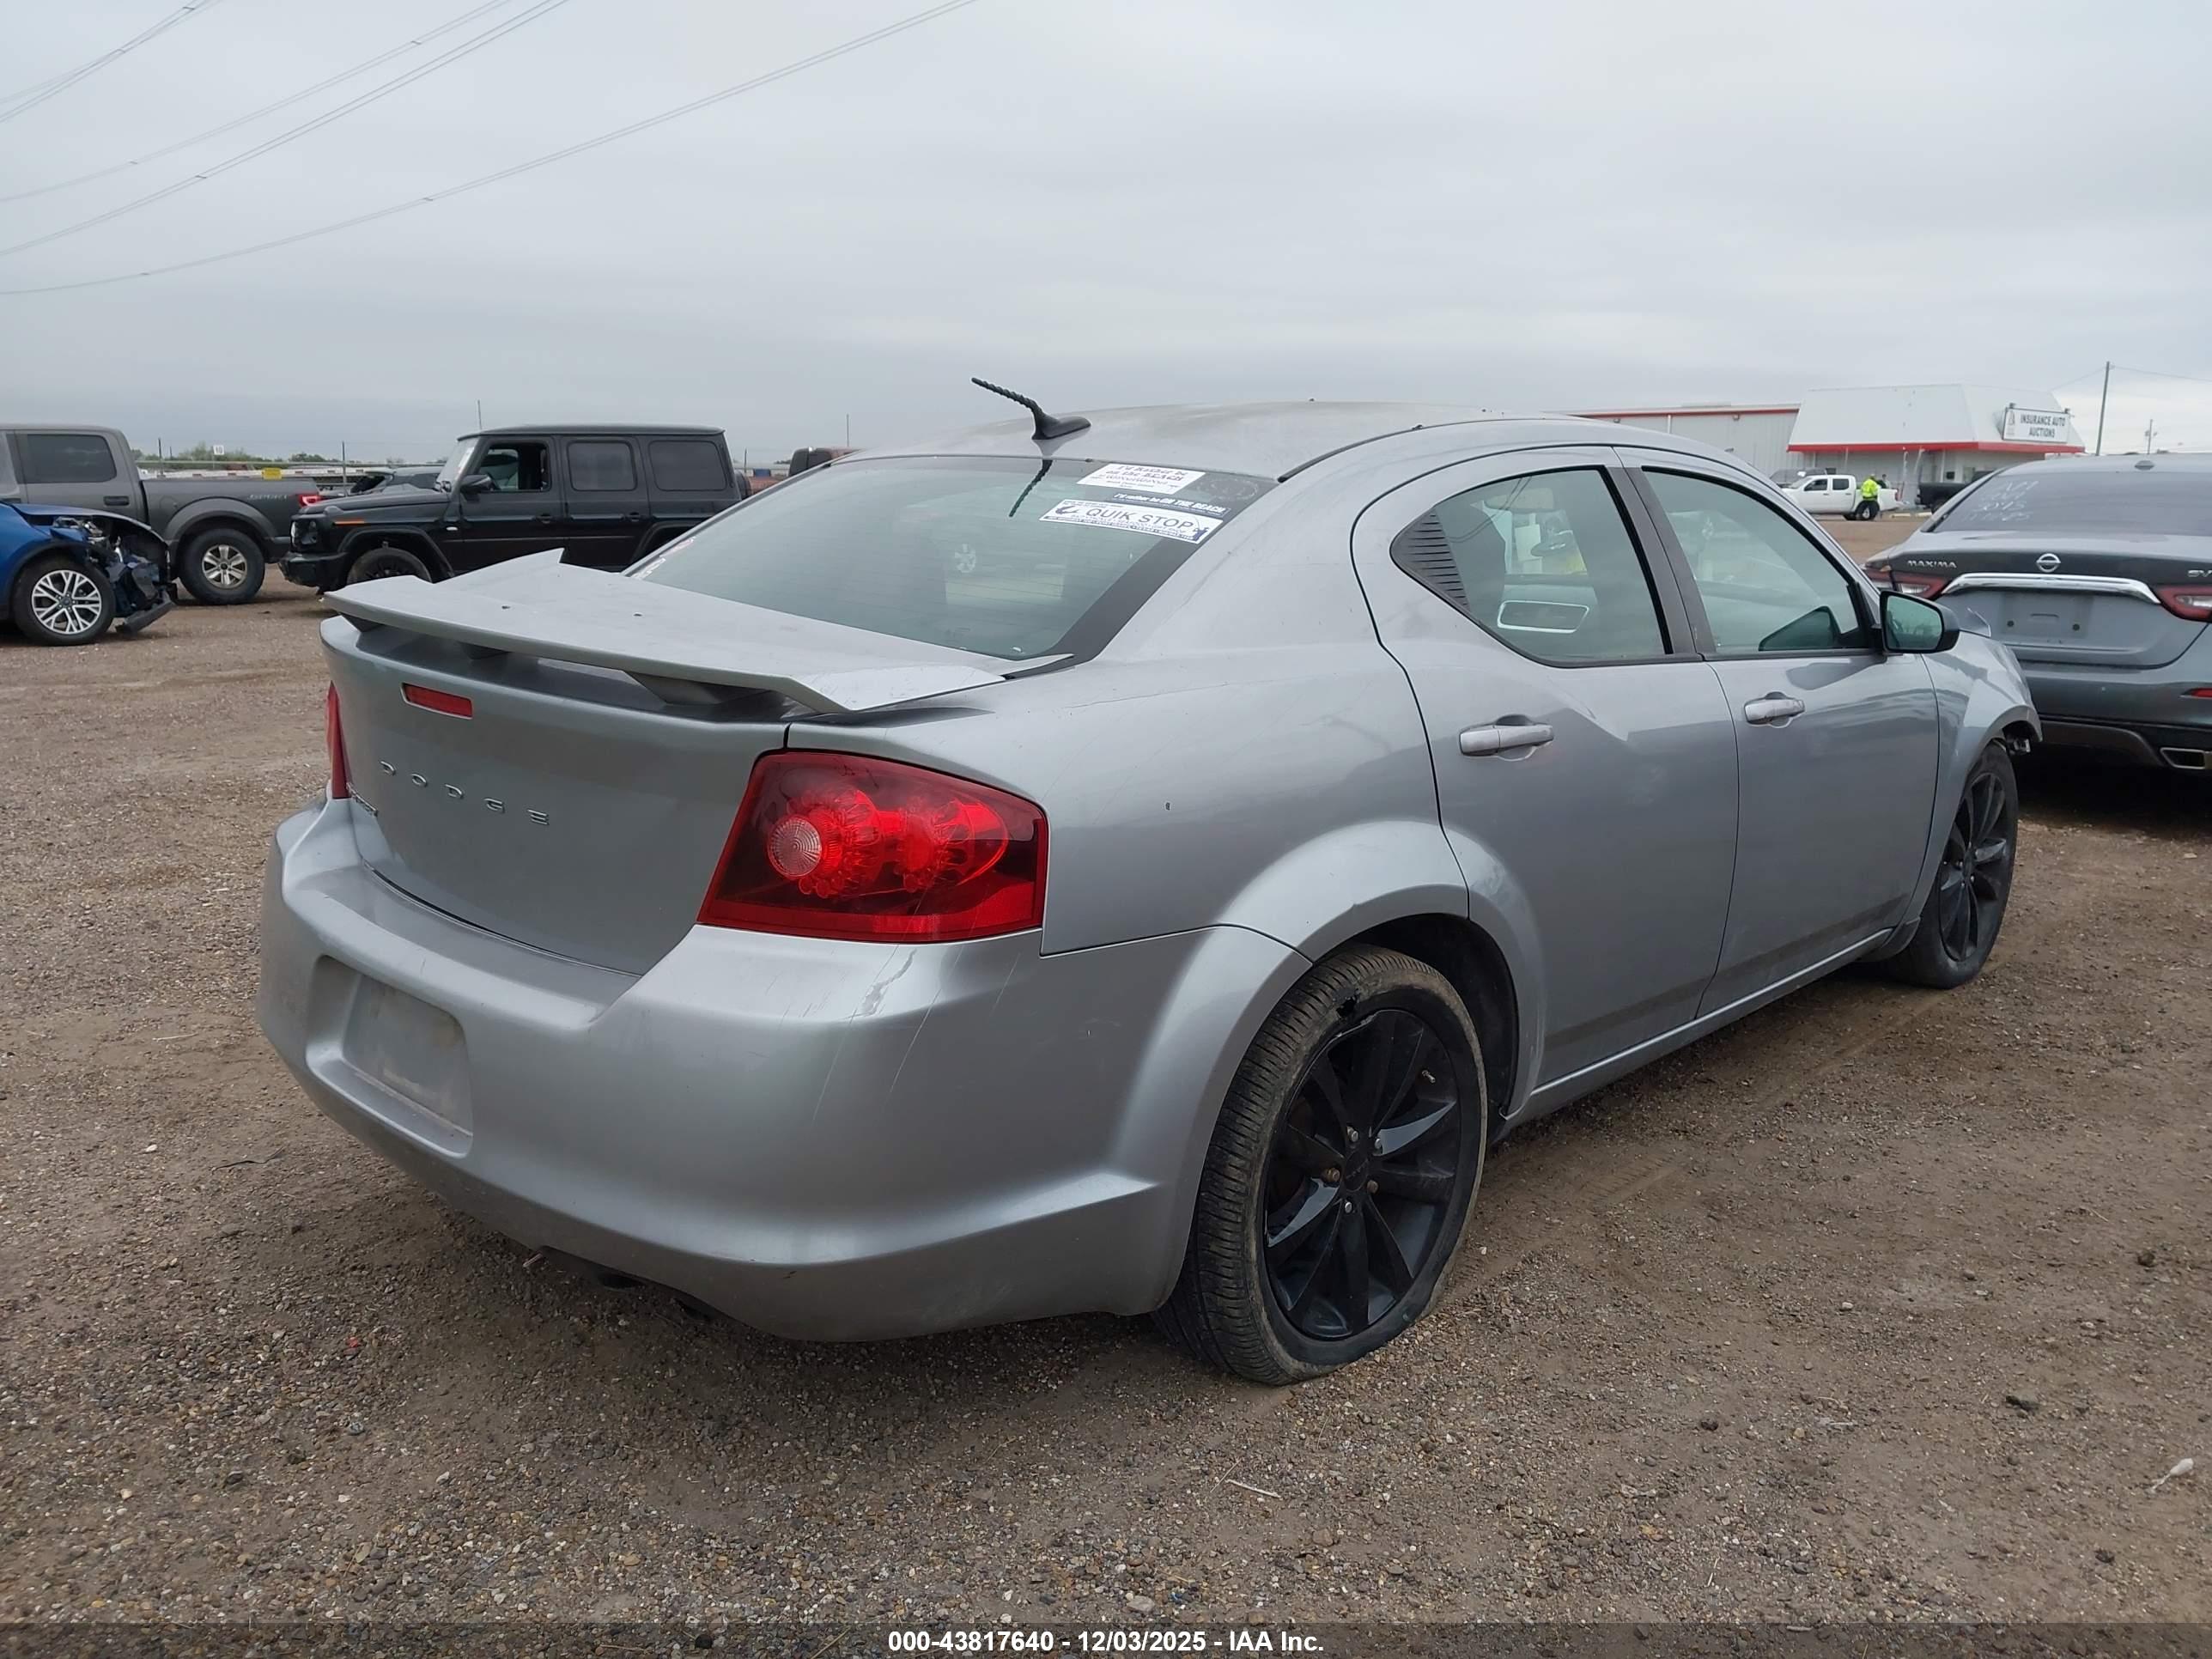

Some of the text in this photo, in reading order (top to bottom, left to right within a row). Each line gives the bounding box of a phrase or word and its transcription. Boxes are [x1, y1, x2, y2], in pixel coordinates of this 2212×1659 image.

[2020, 414, 2066, 427] INSURANCE AUTO
[2028, 427, 2056, 439] AUCTIONS
[1085, 507, 1137, 520] QUIK
[1138, 514, 1194, 529] STOP
[1907, 560, 1957, 568] MAXIMA
[380, 761, 549, 825] DODGE
